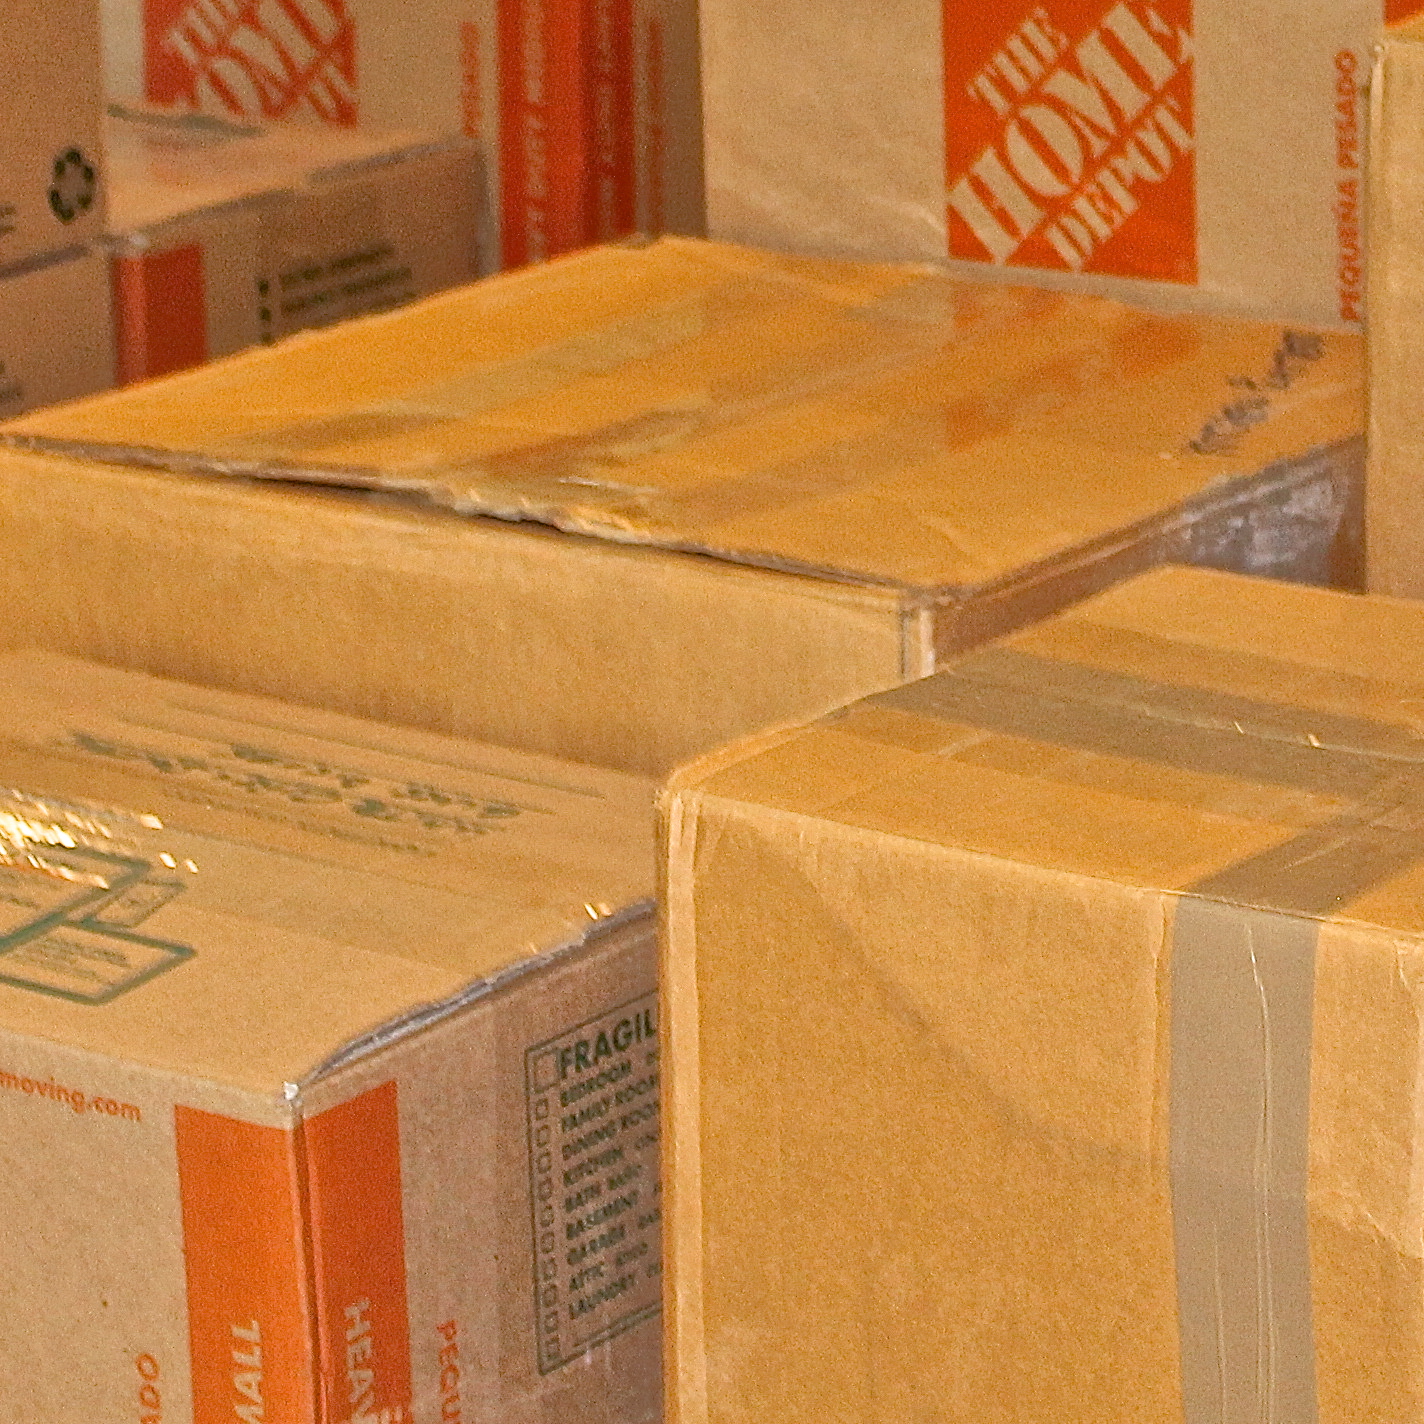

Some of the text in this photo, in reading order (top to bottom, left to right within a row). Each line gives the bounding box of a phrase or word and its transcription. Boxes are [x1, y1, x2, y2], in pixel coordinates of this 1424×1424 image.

[966, 7, 1069, 118] THE
[1045, 95, 1196, 274] DEPOT
[559, 1008, 657, 1081] FRAGIL
[230, 1317, 266, 1424] MALL
[436, 1318, 464, 1424] PEQU
